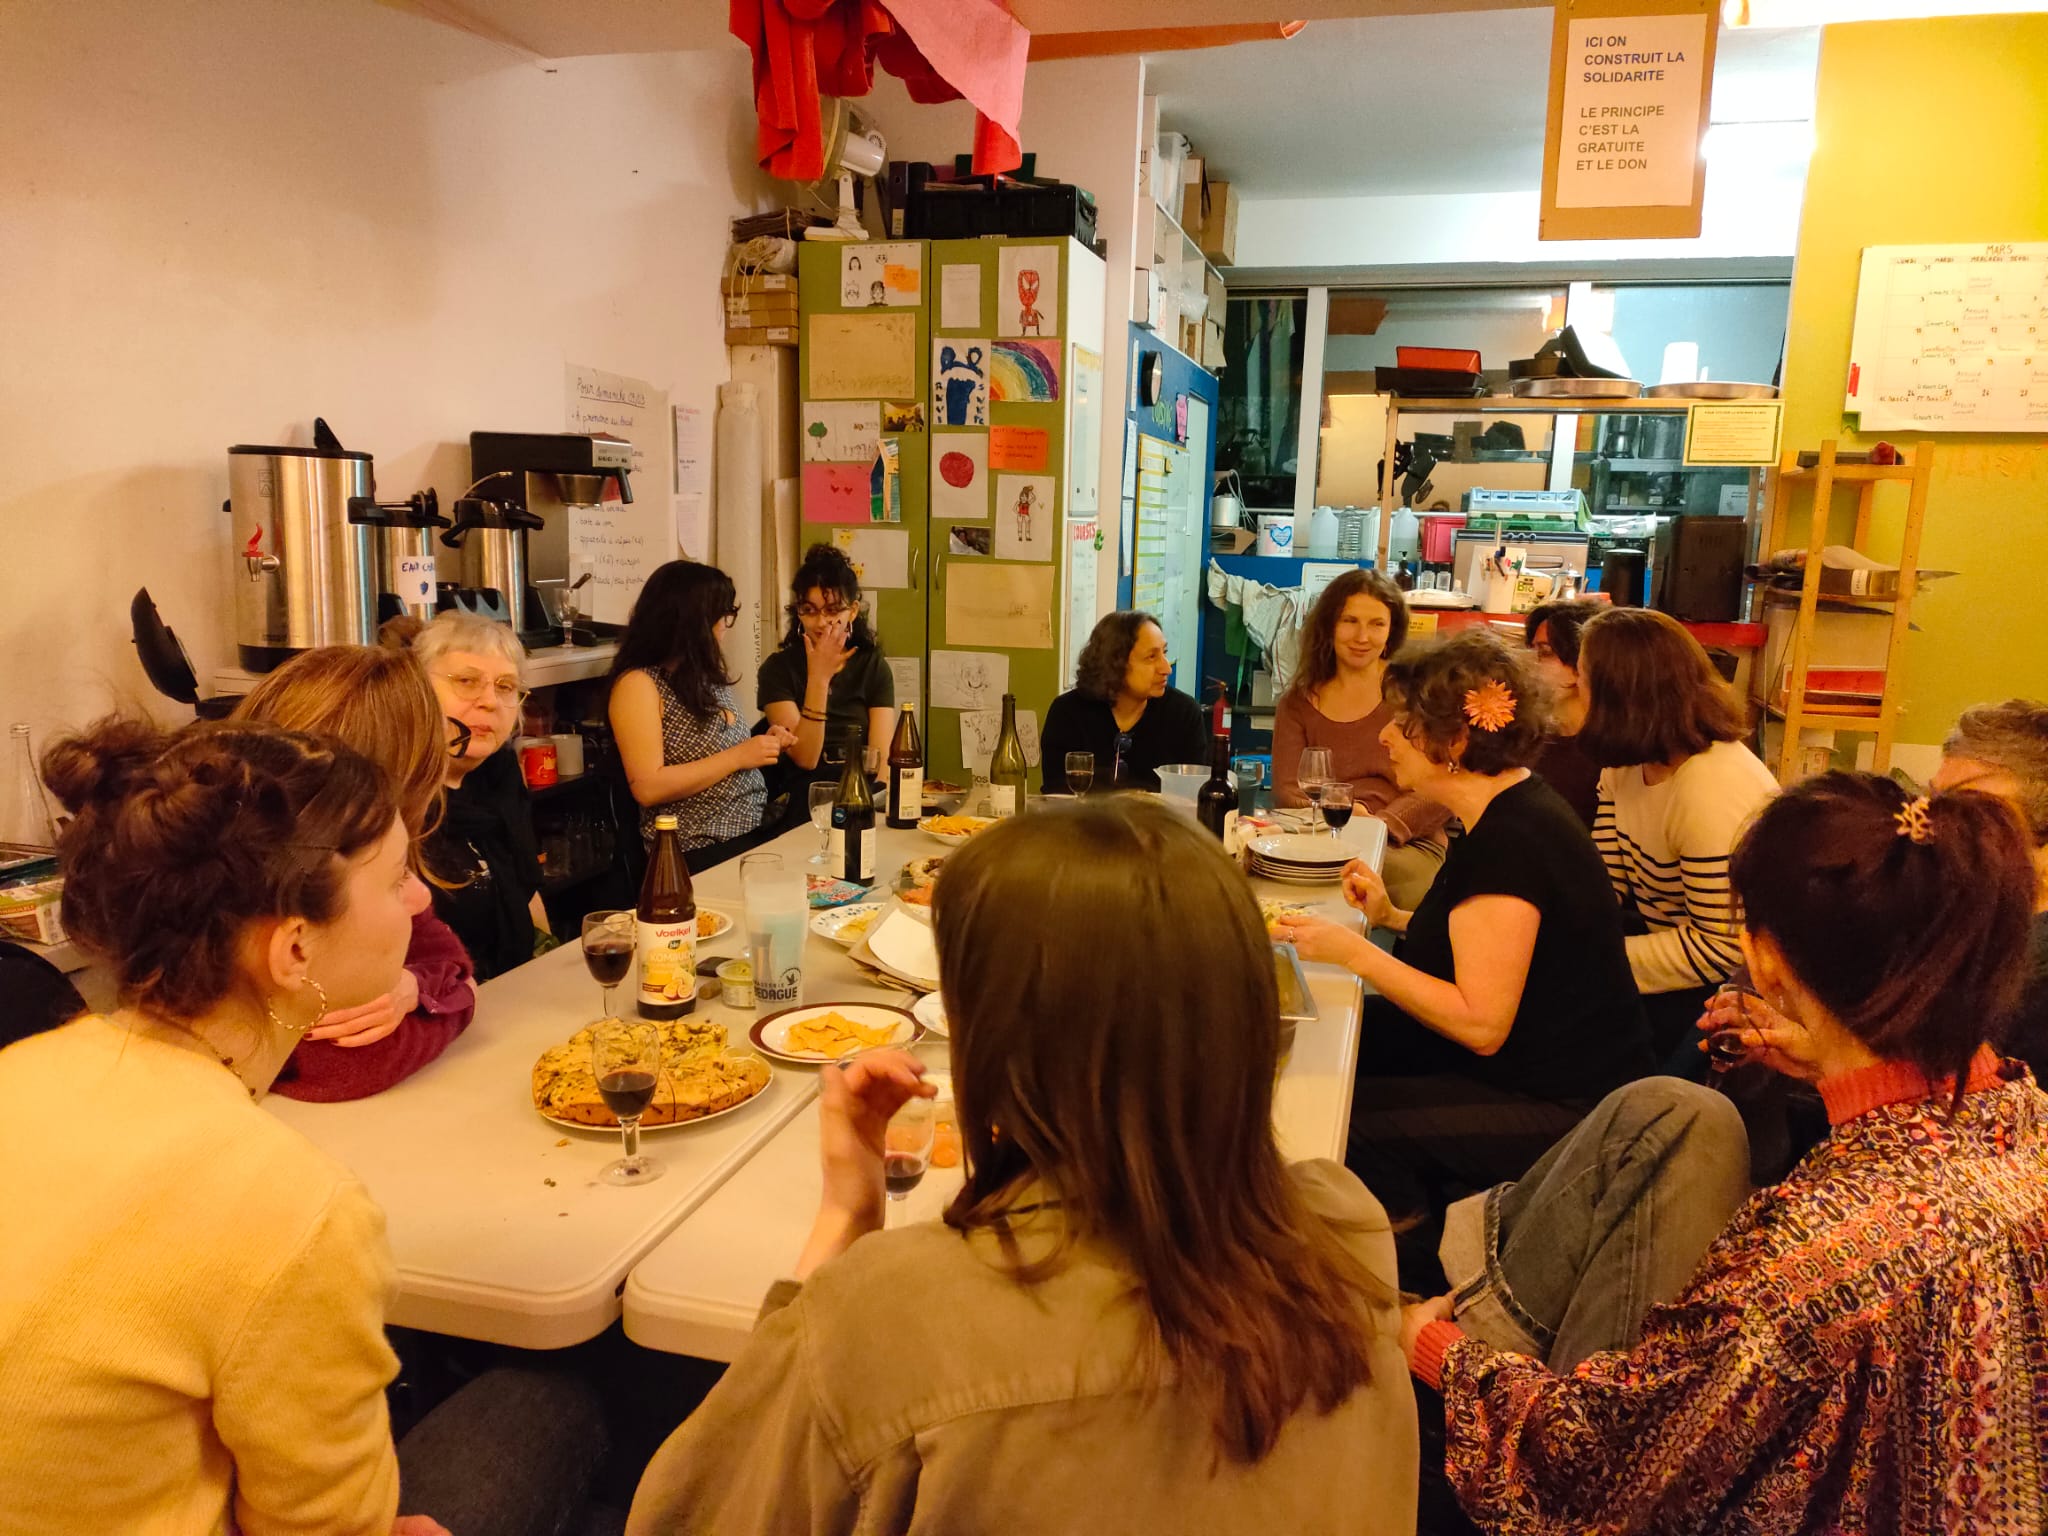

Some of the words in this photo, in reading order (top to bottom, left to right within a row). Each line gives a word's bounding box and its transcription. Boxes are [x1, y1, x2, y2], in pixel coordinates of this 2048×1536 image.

[1585, 36, 1603, 48] ICI
[1606, 36, 1627, 47] ON
[1584, 52, 1664, 66] CONSTRUIT
[1667, 51, 1685, 63] LA
[1583, 70, 1665, 83] SOLIDARITE
[1580, 107, 1597, 118] LE
[1601, 105, 1665, 118] PRINCIPE
[1579, 124, 1618, 136] C'EST
[1622, 124, 1639, 135] LA
[1577, 141, 1645, 153] GRATUITE
[1576, 159, 1593, 171] ET
[1597, 159, 1614, 170] LE
[1617, 158, 1648, 170] DON
[1986, 244, 2014, 255] MARS
